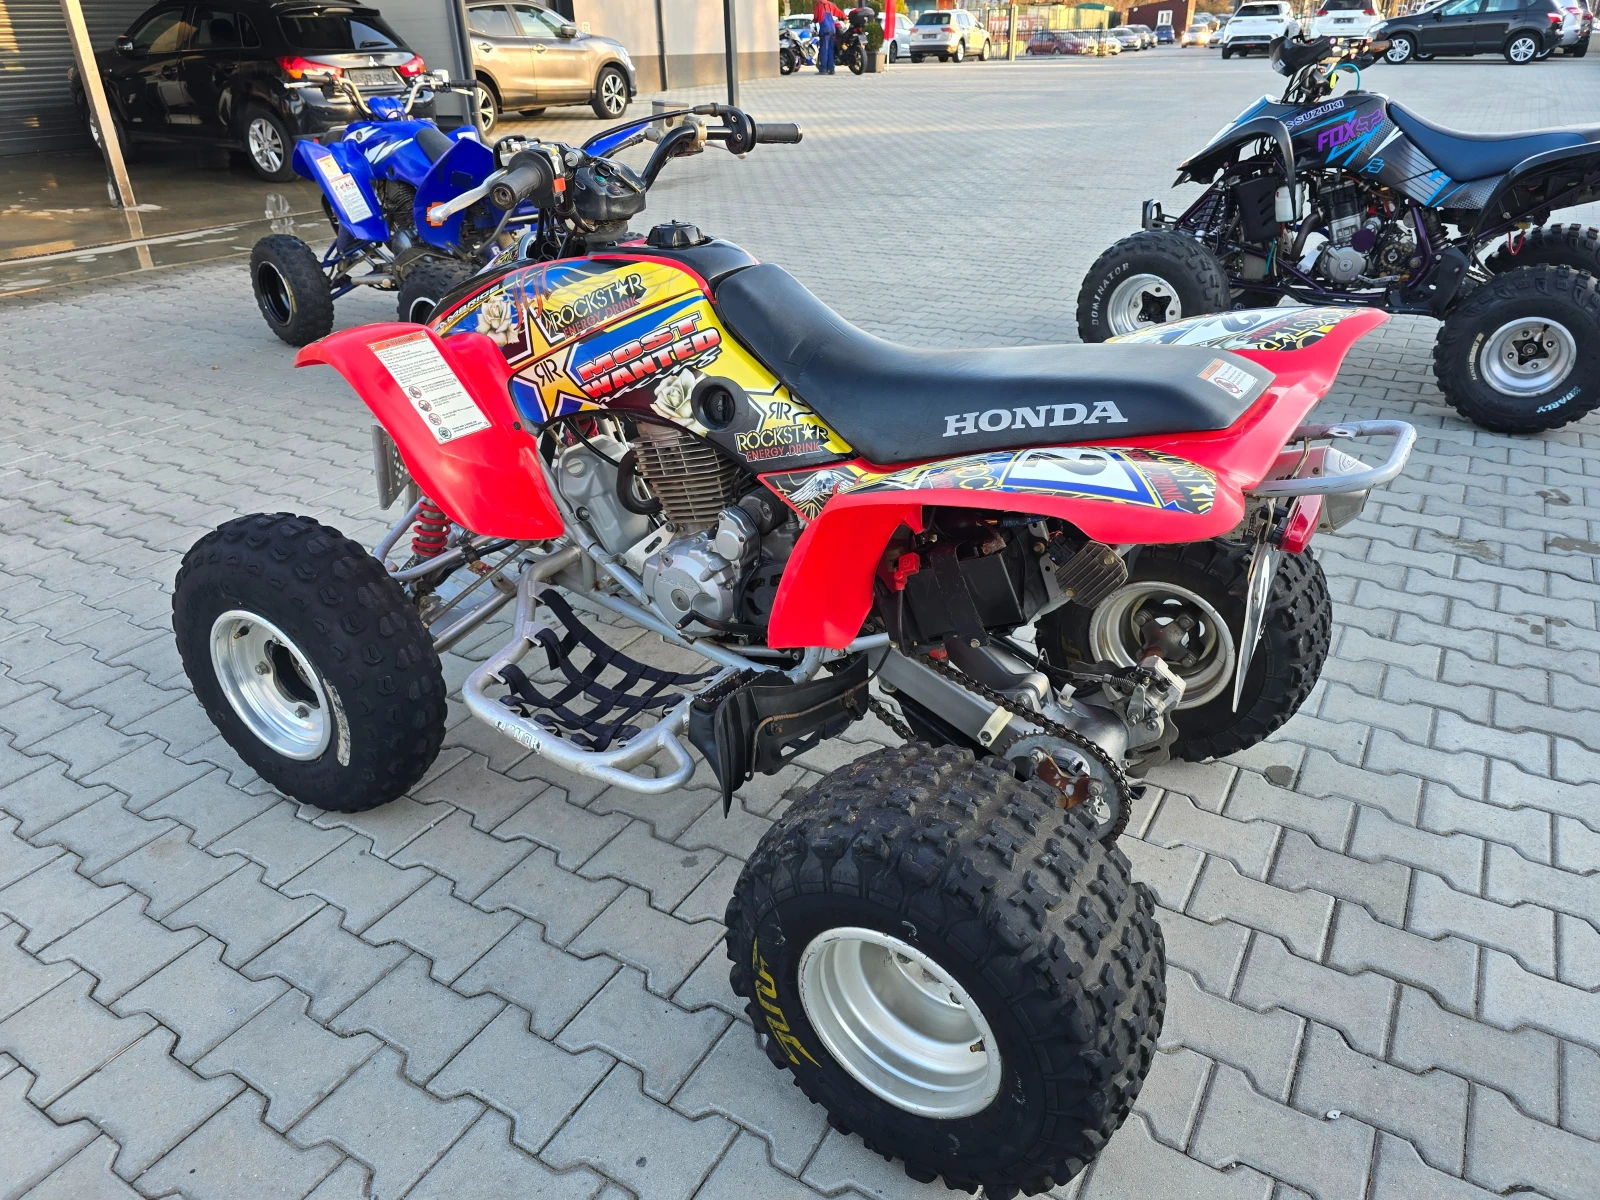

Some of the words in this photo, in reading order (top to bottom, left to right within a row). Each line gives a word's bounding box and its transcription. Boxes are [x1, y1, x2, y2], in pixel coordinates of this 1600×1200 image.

[1294, 99, 1345, 126] SUZUKI
[1317, 118, 1357, 152] FOX
[1091, 262, 1129, 326] DOMINATOR
[563, 312, 601, 339] ENERGY
[605, 295, 639, 318] DRINK
[577, 311, 701, 382] MOST
[581, 328, 721, 399] WANTED
[943, 400, 1128, 437] HONDA
[746, 446, 785, 460] ENERGY
[789, 440, 820, 455] DRINK
